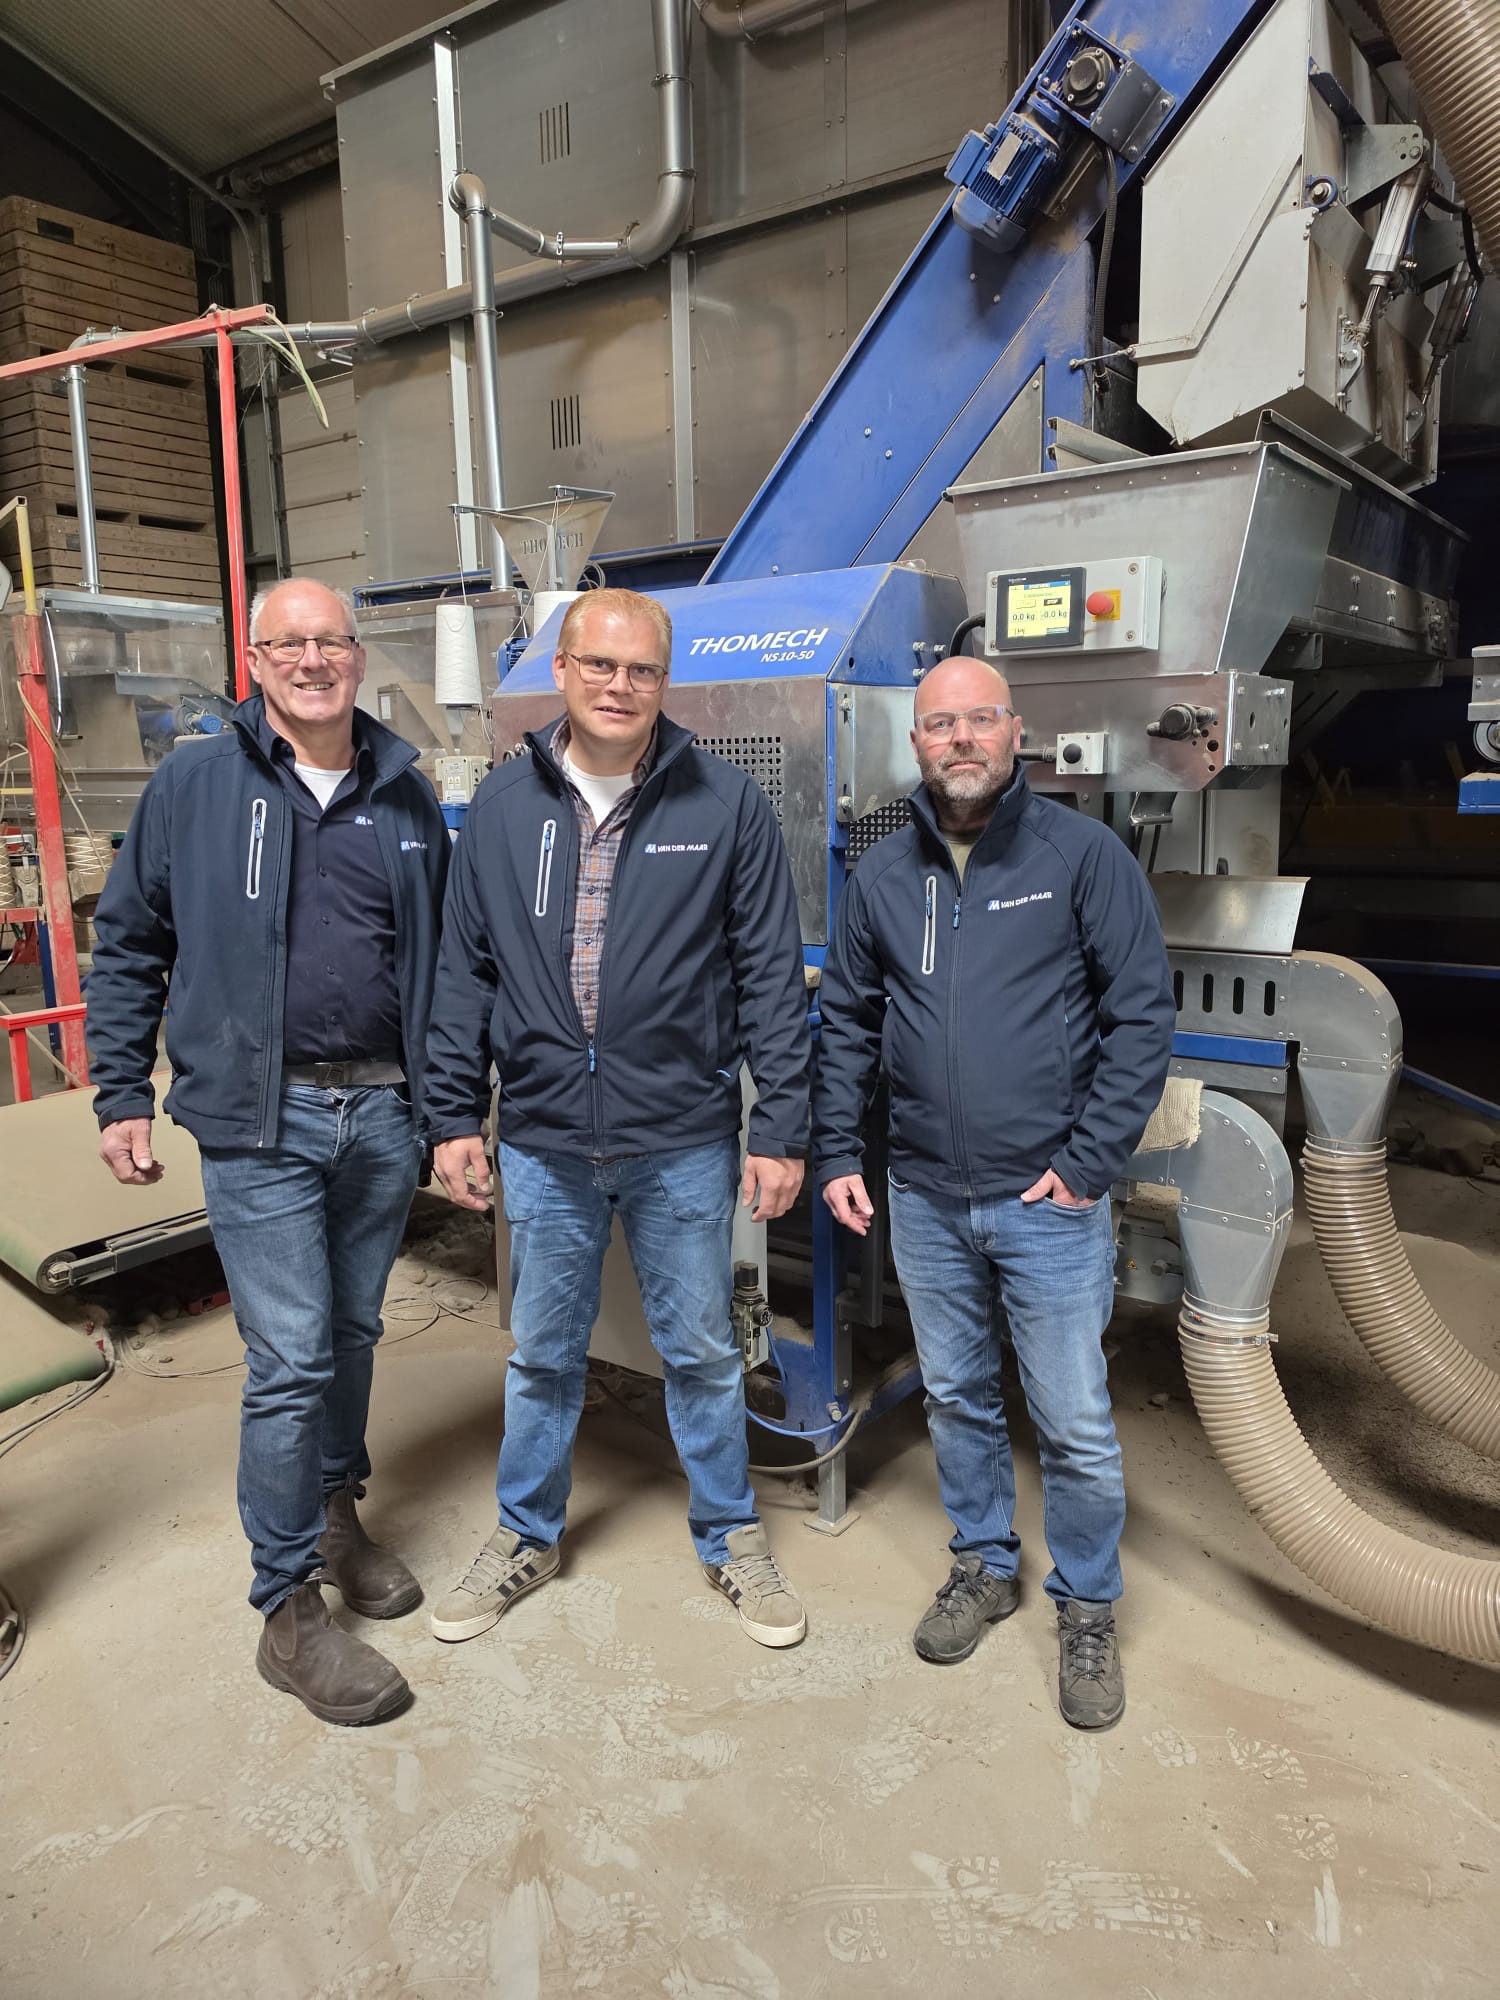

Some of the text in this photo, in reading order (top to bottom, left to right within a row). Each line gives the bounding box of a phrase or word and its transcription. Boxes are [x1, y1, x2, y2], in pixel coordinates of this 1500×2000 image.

[520, 533, 584, 555] THOECH
[689, 627, 829, 656] THOMECH
[657, 845, 671, 853] VAN
[671, 844, 685, 852] DER
[686, 843, 708, 851] MAAR
[1000, 899, 1015, 909] VAN
[1015, 896, 1029, 906] DER
[1029, 891, 1052, 902] MAAR
